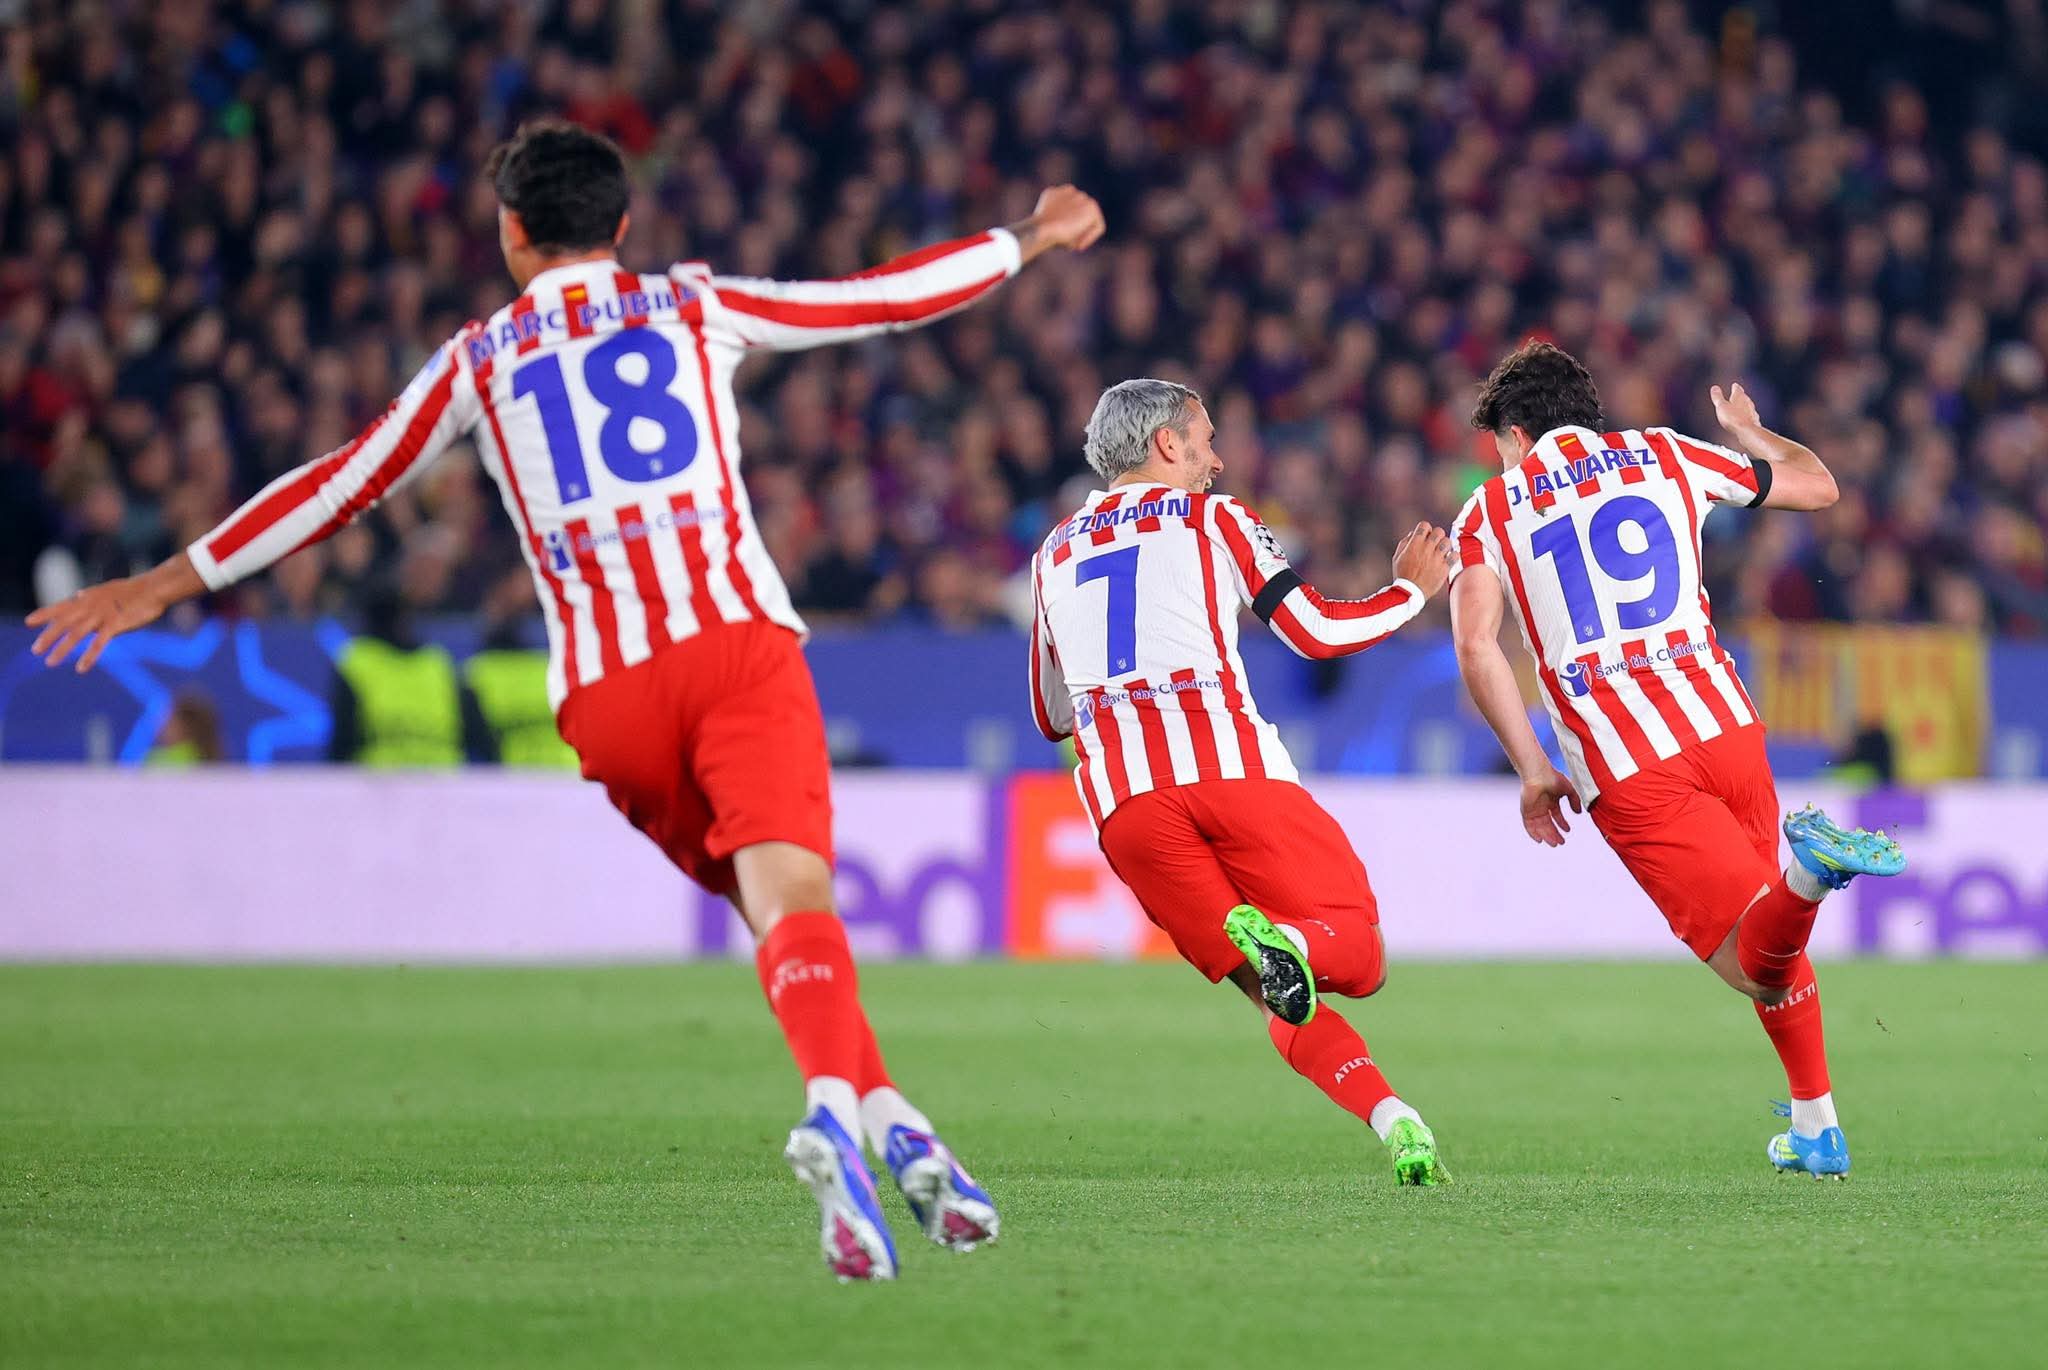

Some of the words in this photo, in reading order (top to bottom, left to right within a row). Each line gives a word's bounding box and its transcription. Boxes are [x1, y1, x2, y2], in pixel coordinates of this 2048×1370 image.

[467, 306, 567, 364] MARC
[511, 326, 699, 505] 18
[1507, 485, 1531, 506] J.
[1534, 448, 1657, 496] ALVAREZ
[1530, 495, 1681, 645] 19
[1075, 544, 1141, 679] 7
[1595, 660, 1629, 679] Save
[1631, 653, 1655, 669] the
[1656, 640, 1712, 663] Children
[1100, 692, 1129, 708] Save
[1132, 688, 1157, 700] the
[1159, 679, 1222, 695] Children
[1333, 1056, 1374, 1085] ATLETI
